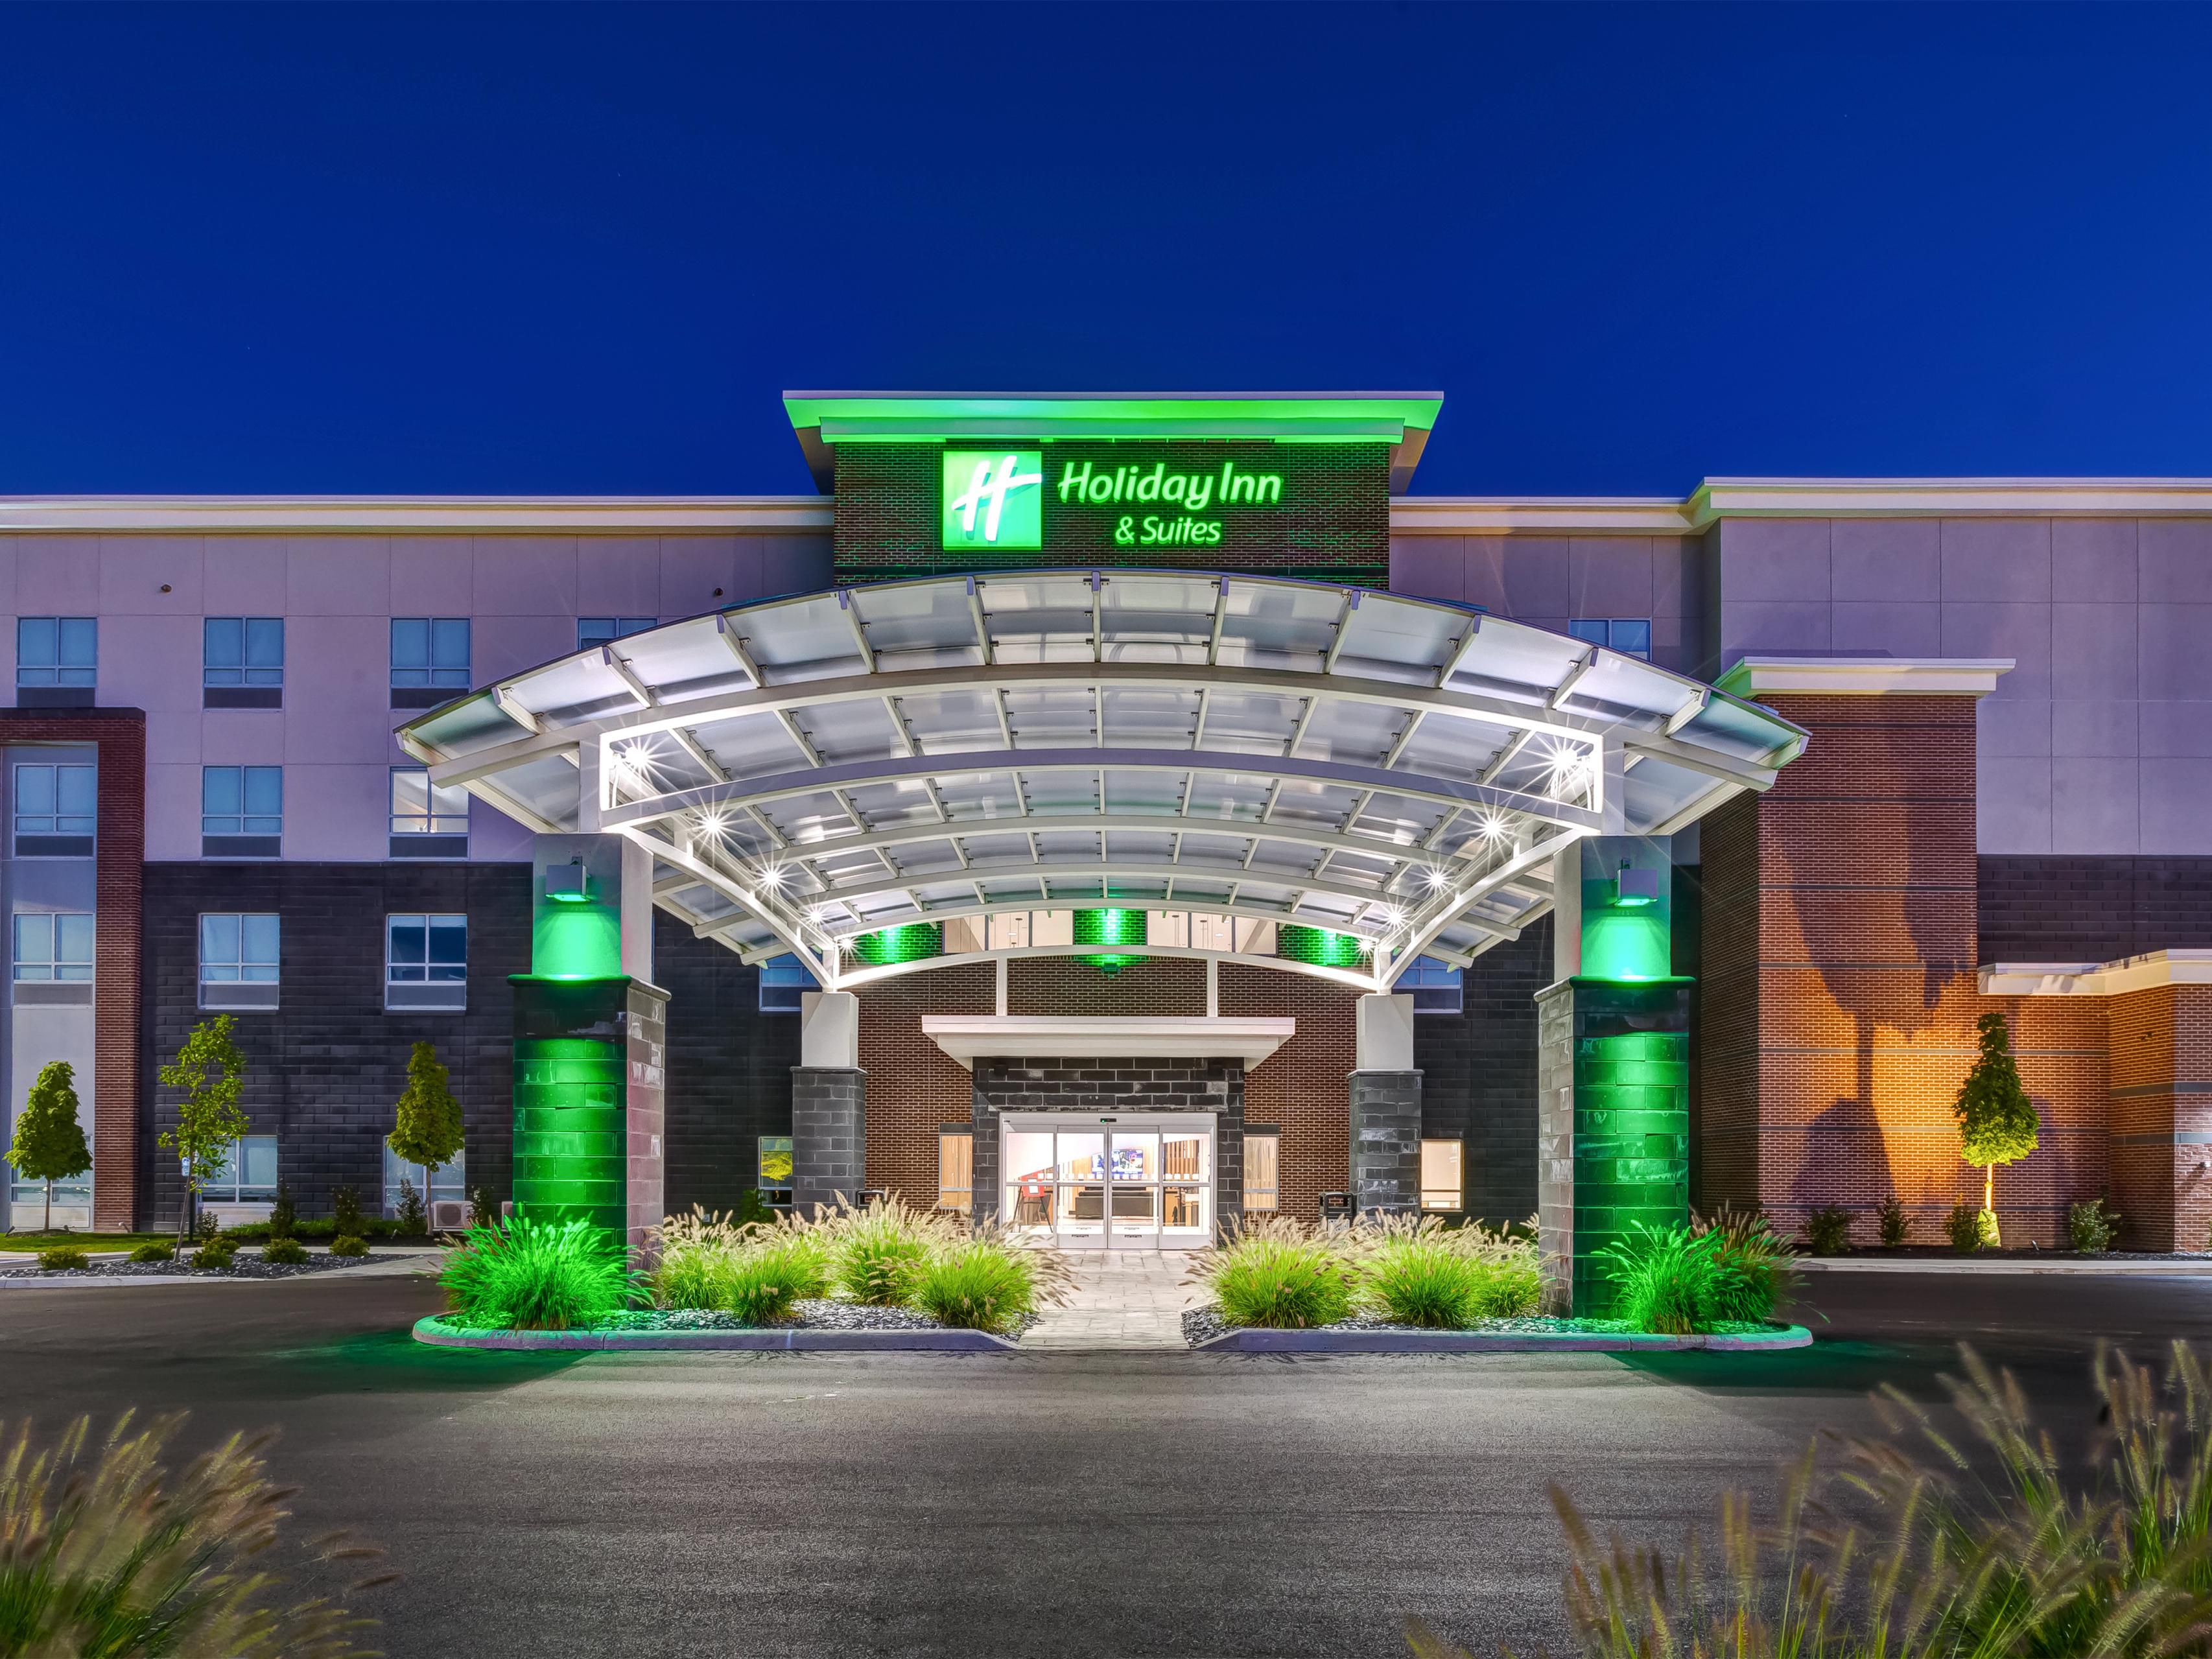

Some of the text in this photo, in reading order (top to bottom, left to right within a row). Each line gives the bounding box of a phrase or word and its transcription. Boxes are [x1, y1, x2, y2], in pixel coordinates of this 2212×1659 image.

[951, 455, 1042, 541] H
[1057, 462, 1281, 510] Holiday Inn
[1115, 516, 1221, 544] & Suites
